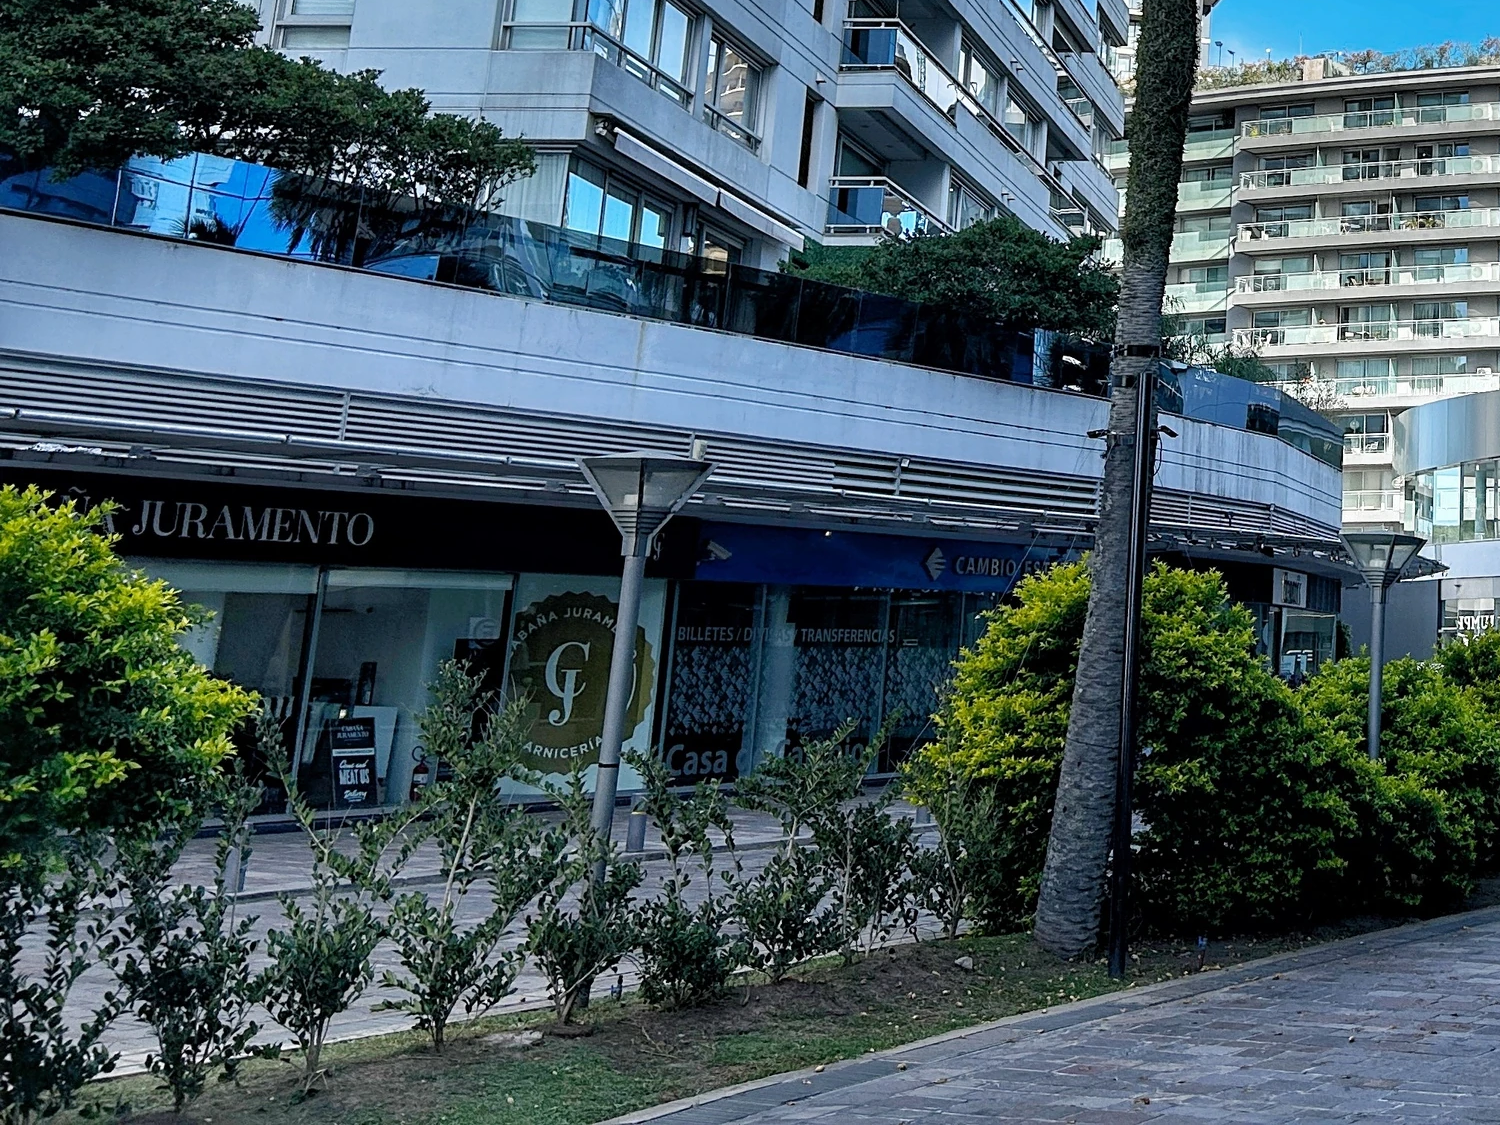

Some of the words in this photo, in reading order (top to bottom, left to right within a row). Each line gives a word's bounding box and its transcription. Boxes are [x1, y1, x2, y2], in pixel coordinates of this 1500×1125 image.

[132, 499, 374, 546] JURAMENTO
[955, 556, 1016, 576] CAMBIO
[510, 611, 558, 658] ABAÑA
[677, 626, 734, 642] BILLETES
[800, 628, 896, 643] TRANSFERENCIAS
[522, 735, 603, 759] ARNICERÍA
[666, 743, 728, 775] Casa
[339, 768, 359, 785] MEAT
[359, 768, 370, 784] US
